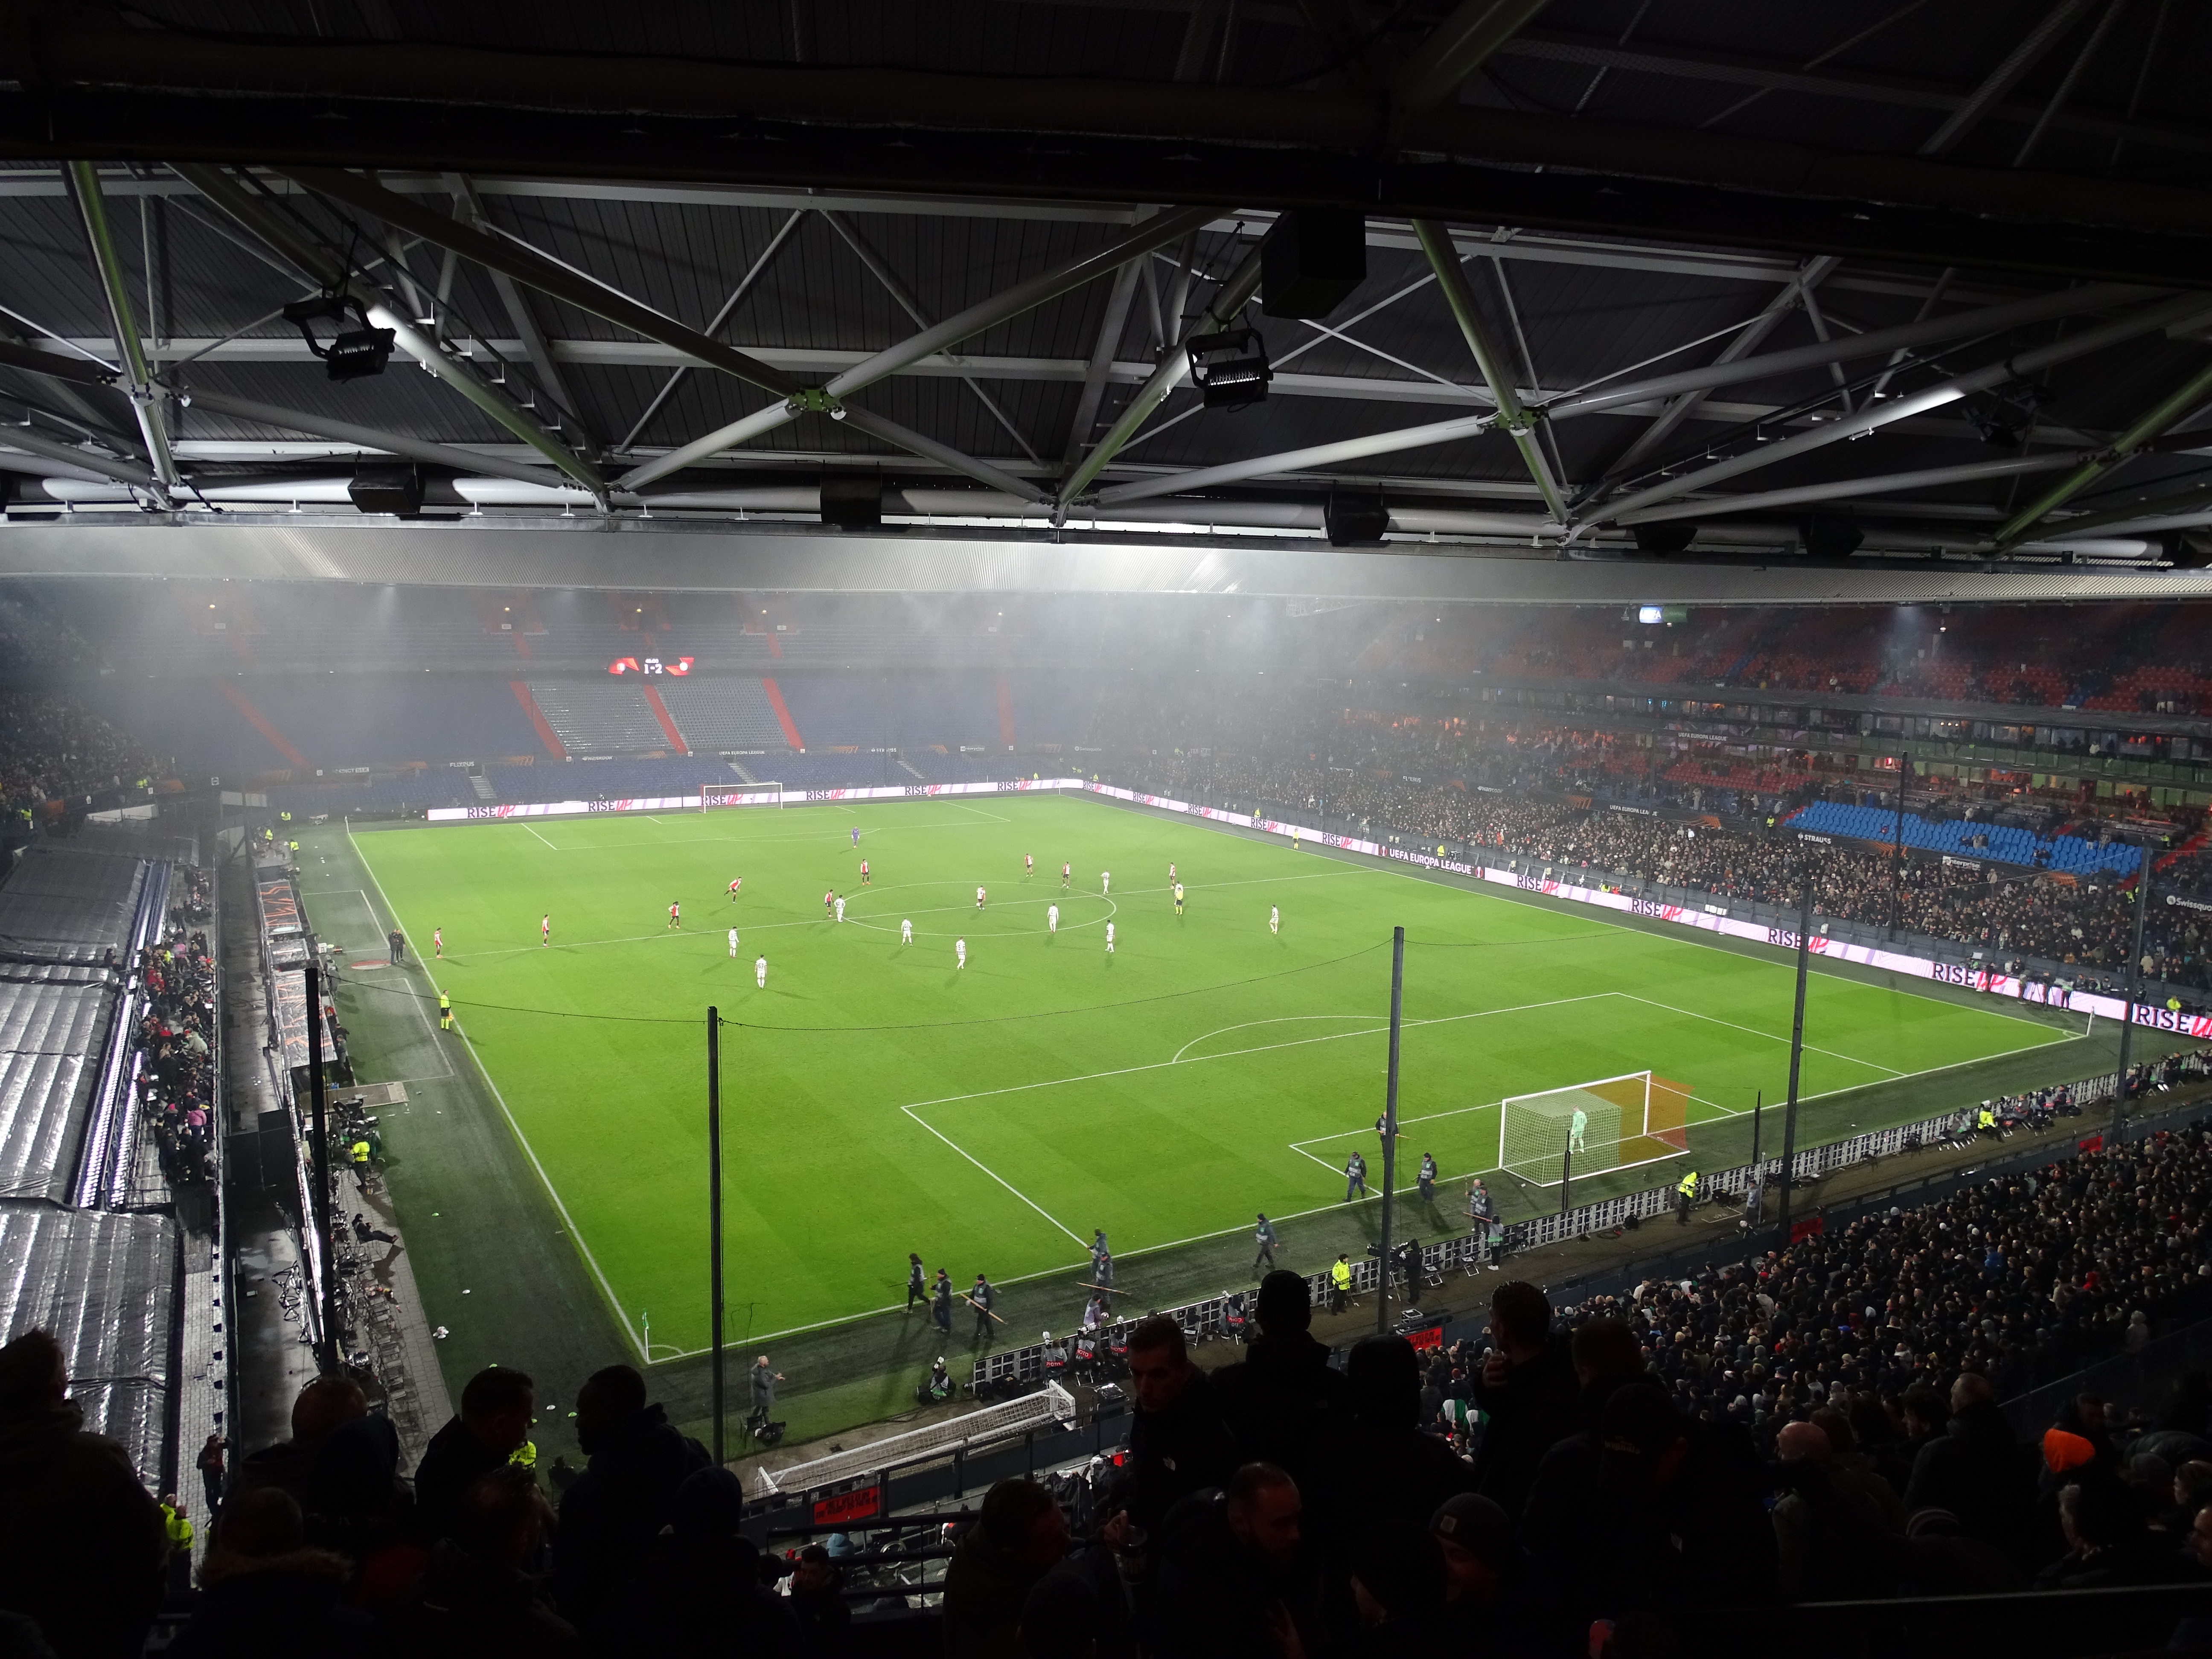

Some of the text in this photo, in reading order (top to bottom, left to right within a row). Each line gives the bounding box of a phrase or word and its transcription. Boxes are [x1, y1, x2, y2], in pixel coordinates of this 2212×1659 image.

[644, 664, 662, 674] 1-2
[905, 786, 927, 796] RISE
[997, 781, 1018, 791] RISE
[1083, 780, 1094, 791] RISE
[701, 795, 726, 806] RISE
[806, 790, 830, 800] RISE
[1133, 792, 1145, 803] RISE
[468, 806, 496, 818] RISE
[589, 801, 615, 812] RISE
[1188, 804, 1202, 816] RISE
[1251, 818, 1266, 830] RISE
[1322, 833, 1340, 847] RISE
[1804, 834, 1832, 845] STRAUSS
[1389, 848, 1472, 874] UEFA EUROPA LEAGUE
[1517, 875, 1542, 891] RISE
[1631, 898, 1661, 917] RISE
[1932, 963, 1975, 986] RISE
[2136, 1004, 2190, 1033] RISE
